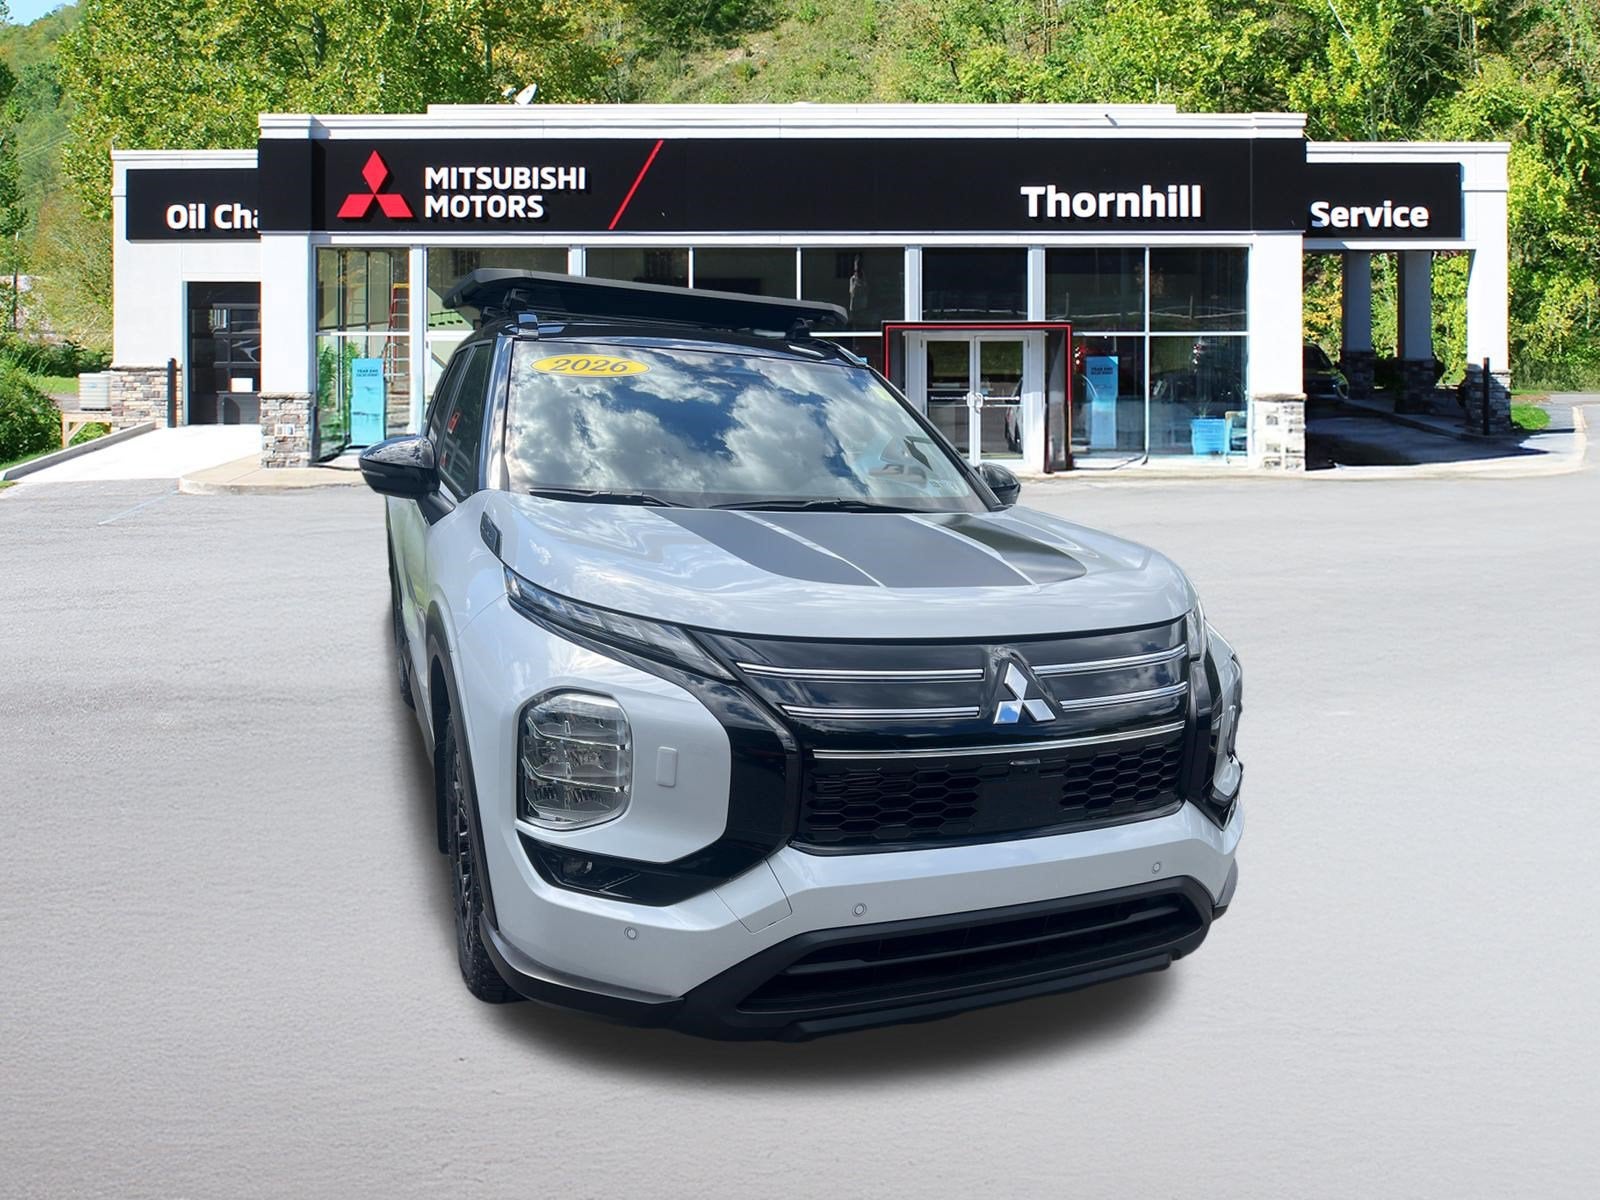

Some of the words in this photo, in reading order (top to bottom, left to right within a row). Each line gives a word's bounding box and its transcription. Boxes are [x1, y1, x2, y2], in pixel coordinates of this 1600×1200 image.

[424, 166, 586, 190] MITSUBISHI
[424, 195, 545, 218] MOTORS
[1020, 184, 1202, 218] Thornhill
[166, 203, 206, 229] Oil
[1310, 200, 1430, 228] Service
[549, 358, 632, 373] 2026
